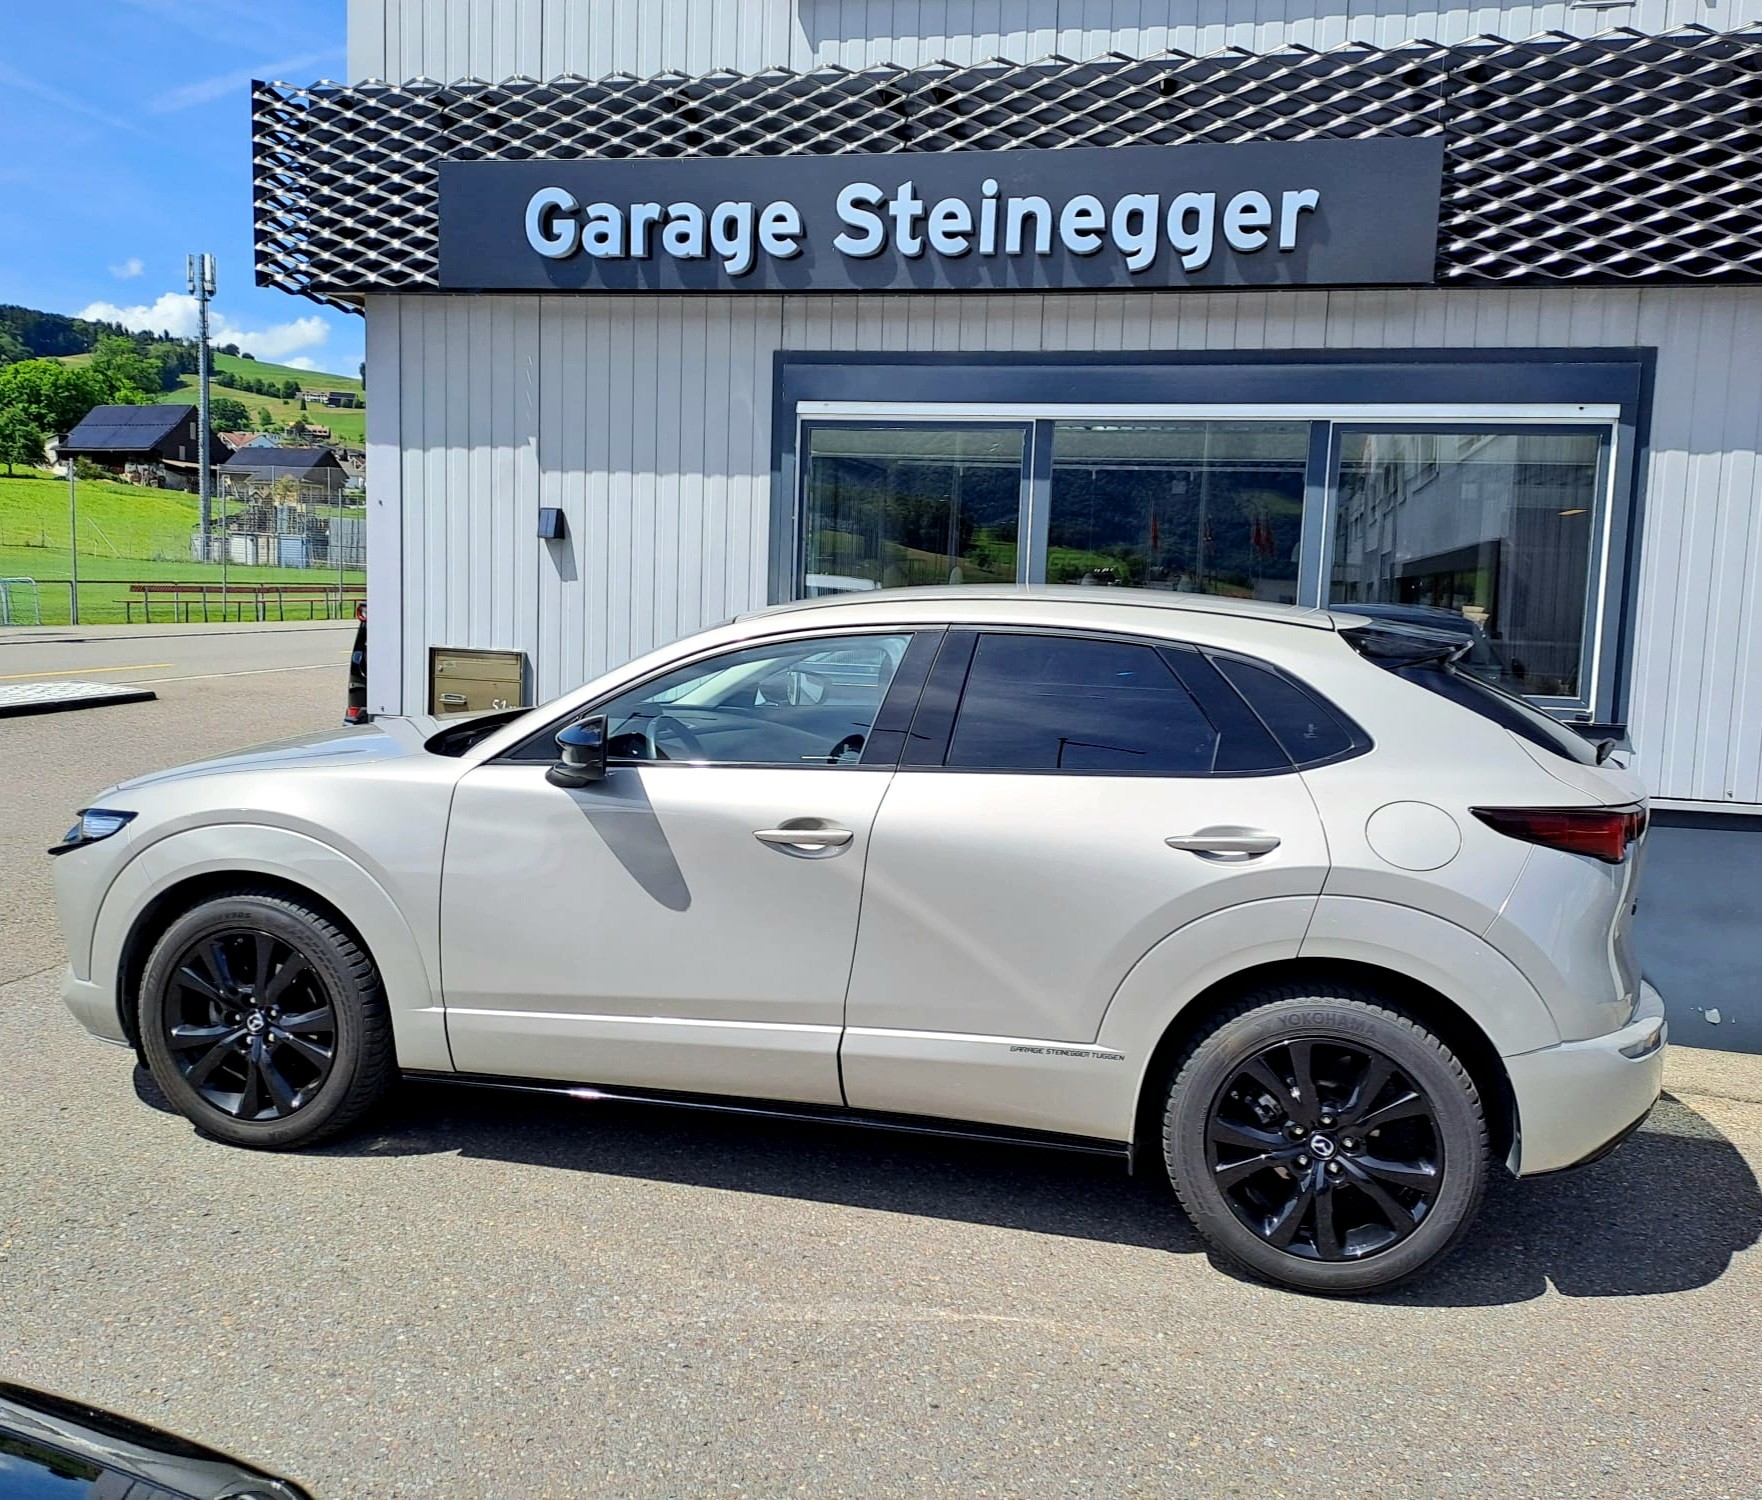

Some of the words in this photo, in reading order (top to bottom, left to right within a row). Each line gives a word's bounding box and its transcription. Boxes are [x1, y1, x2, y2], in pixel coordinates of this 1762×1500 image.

[524, 186, 807, 276] Garage
[832, 178, 1320, 273] Steinegger
[1277, 1012, 1377, 1037] YOKOHAMA
[1010, 1045, 1045, 1055] GARAGE
[1046, 1048, 1090, 1058] STEINEGGER
